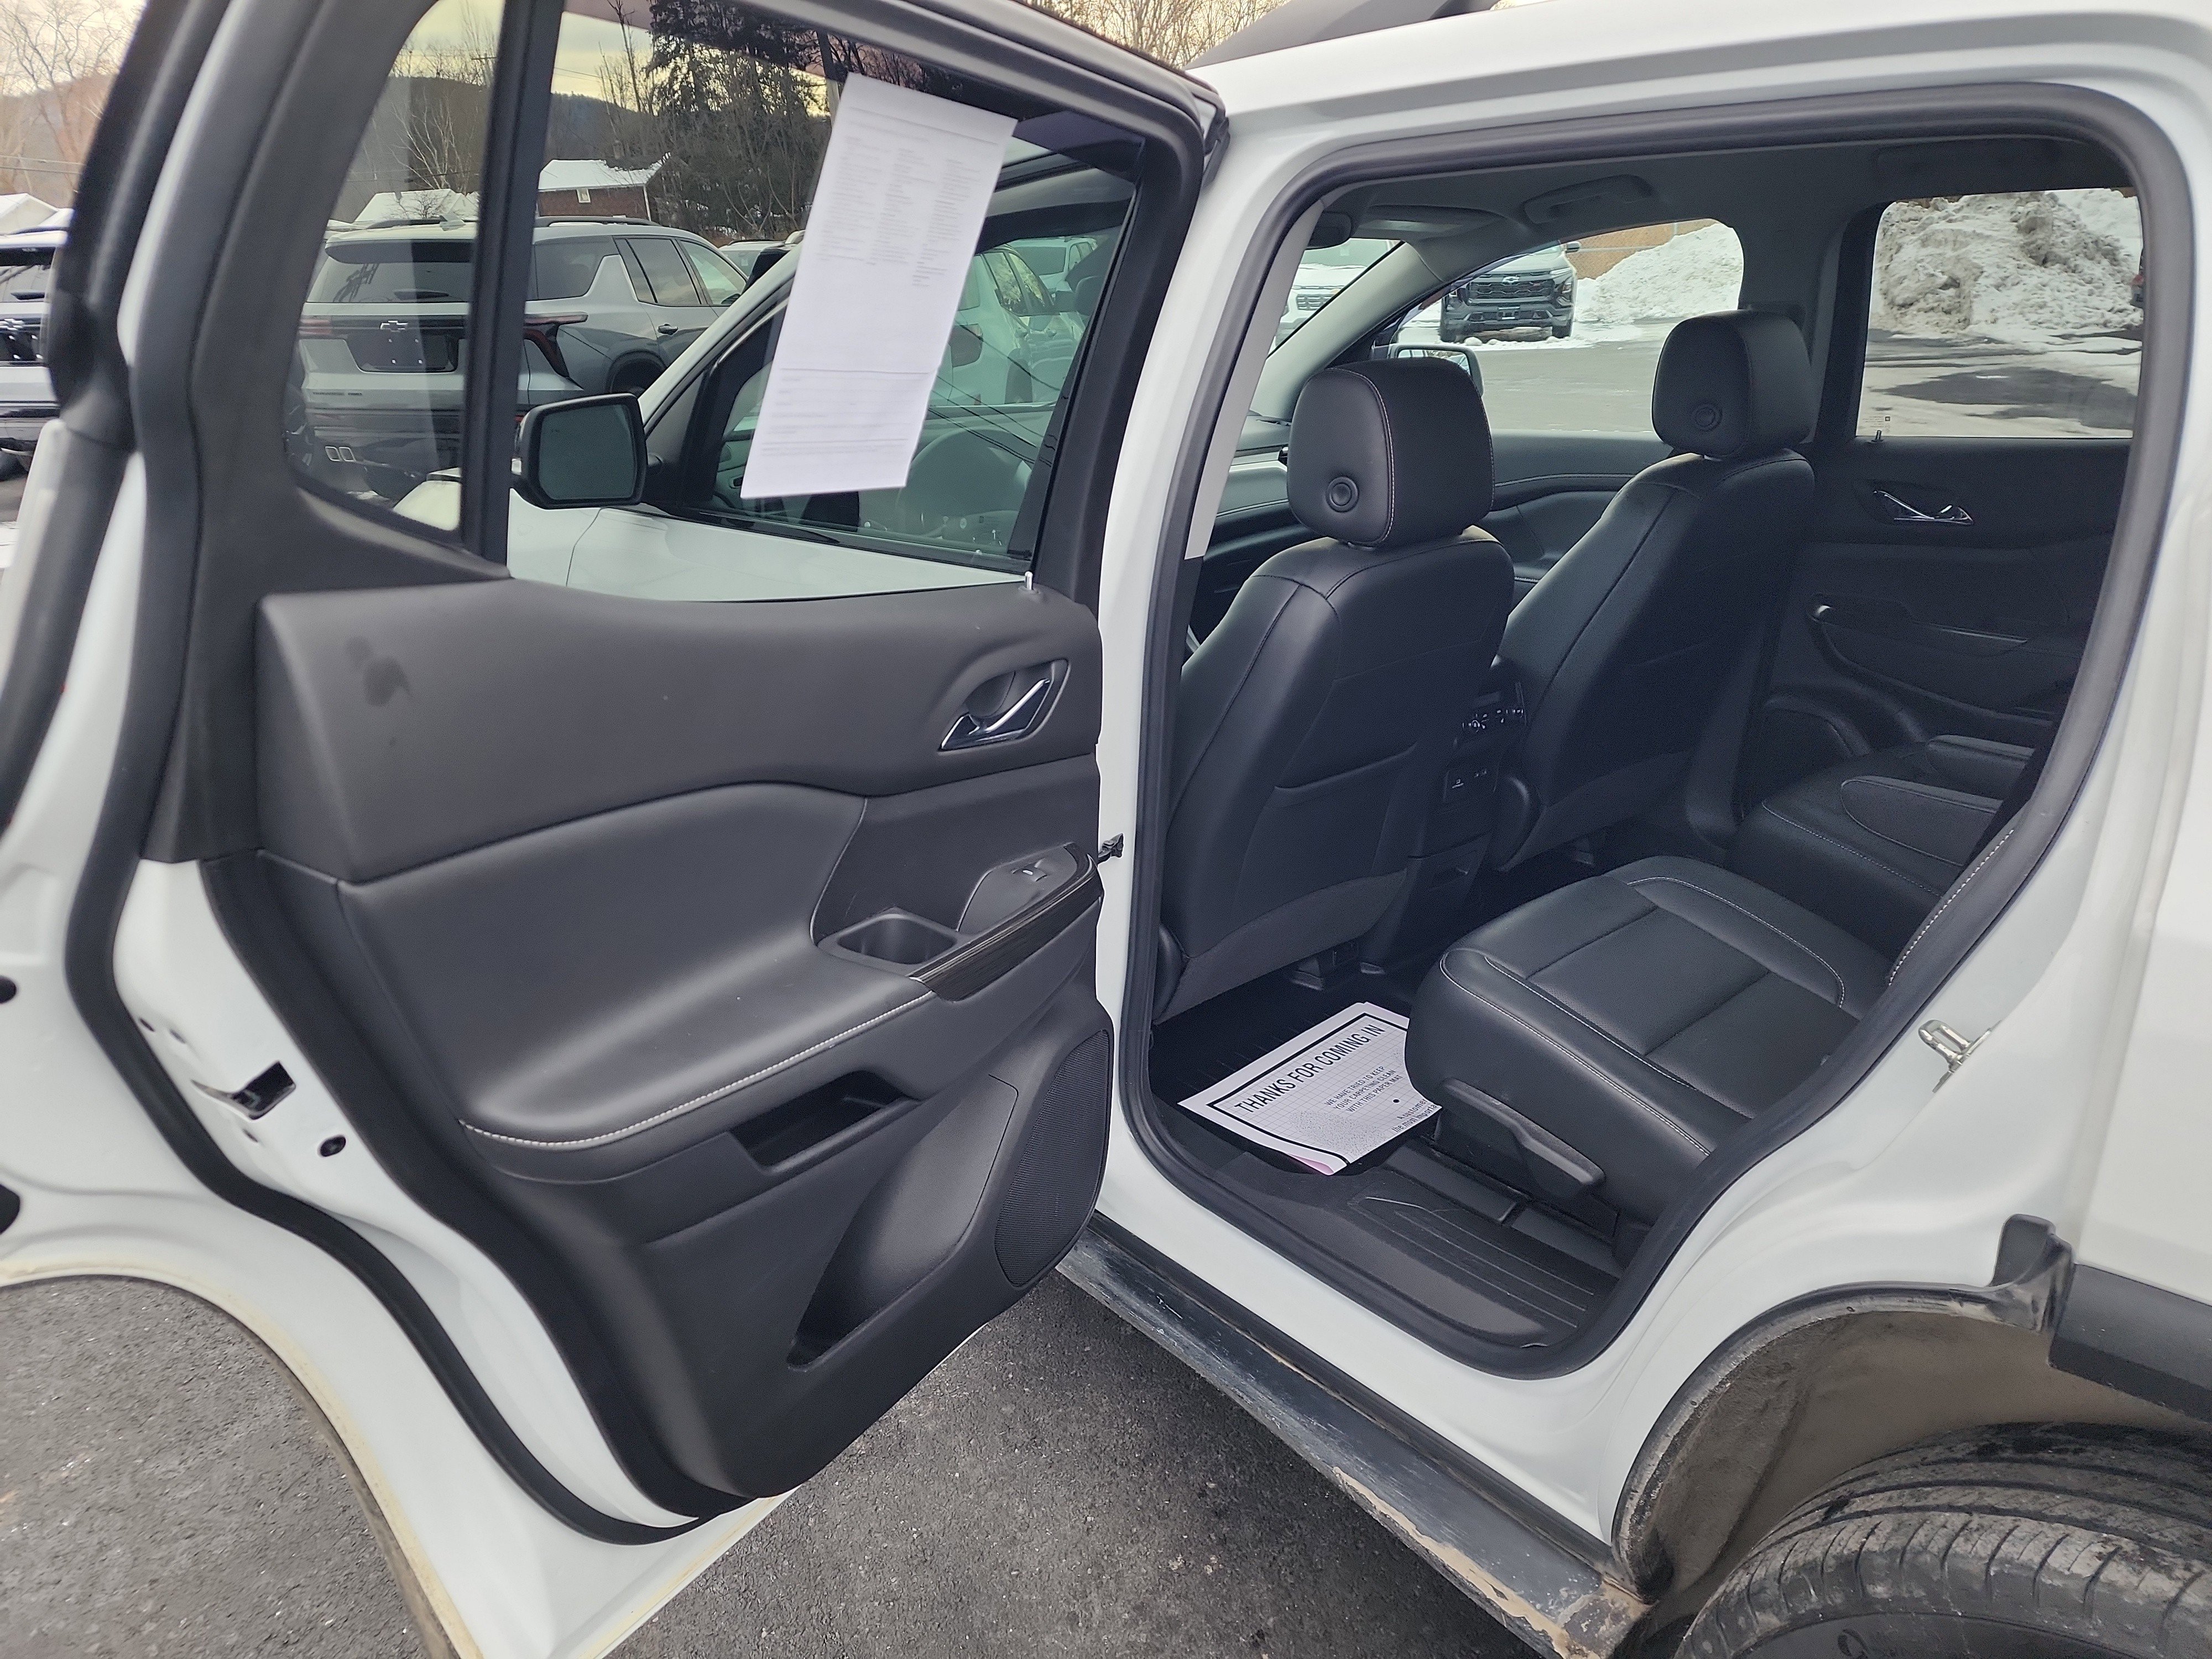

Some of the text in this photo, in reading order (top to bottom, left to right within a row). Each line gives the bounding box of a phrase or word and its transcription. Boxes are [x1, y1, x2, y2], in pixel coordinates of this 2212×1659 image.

[1234, 1025, 1385, 1113] THANKS FOR COMING IN
[1334, 1089, 1350, 1100] HAVE
[1347, 1079, 1365, 1091] TRIED
[1370, 1066, 1385, 1076] KEEP
[1333, 1070, 1396, 1110] YOUR CARPETING CLEAN
[1345, 1074, 1403, 1113] WITH THIS PAPER MAT
[1404, 1099, 1428, 1117] customer
[1402, 1118, 1417, 1128] most
